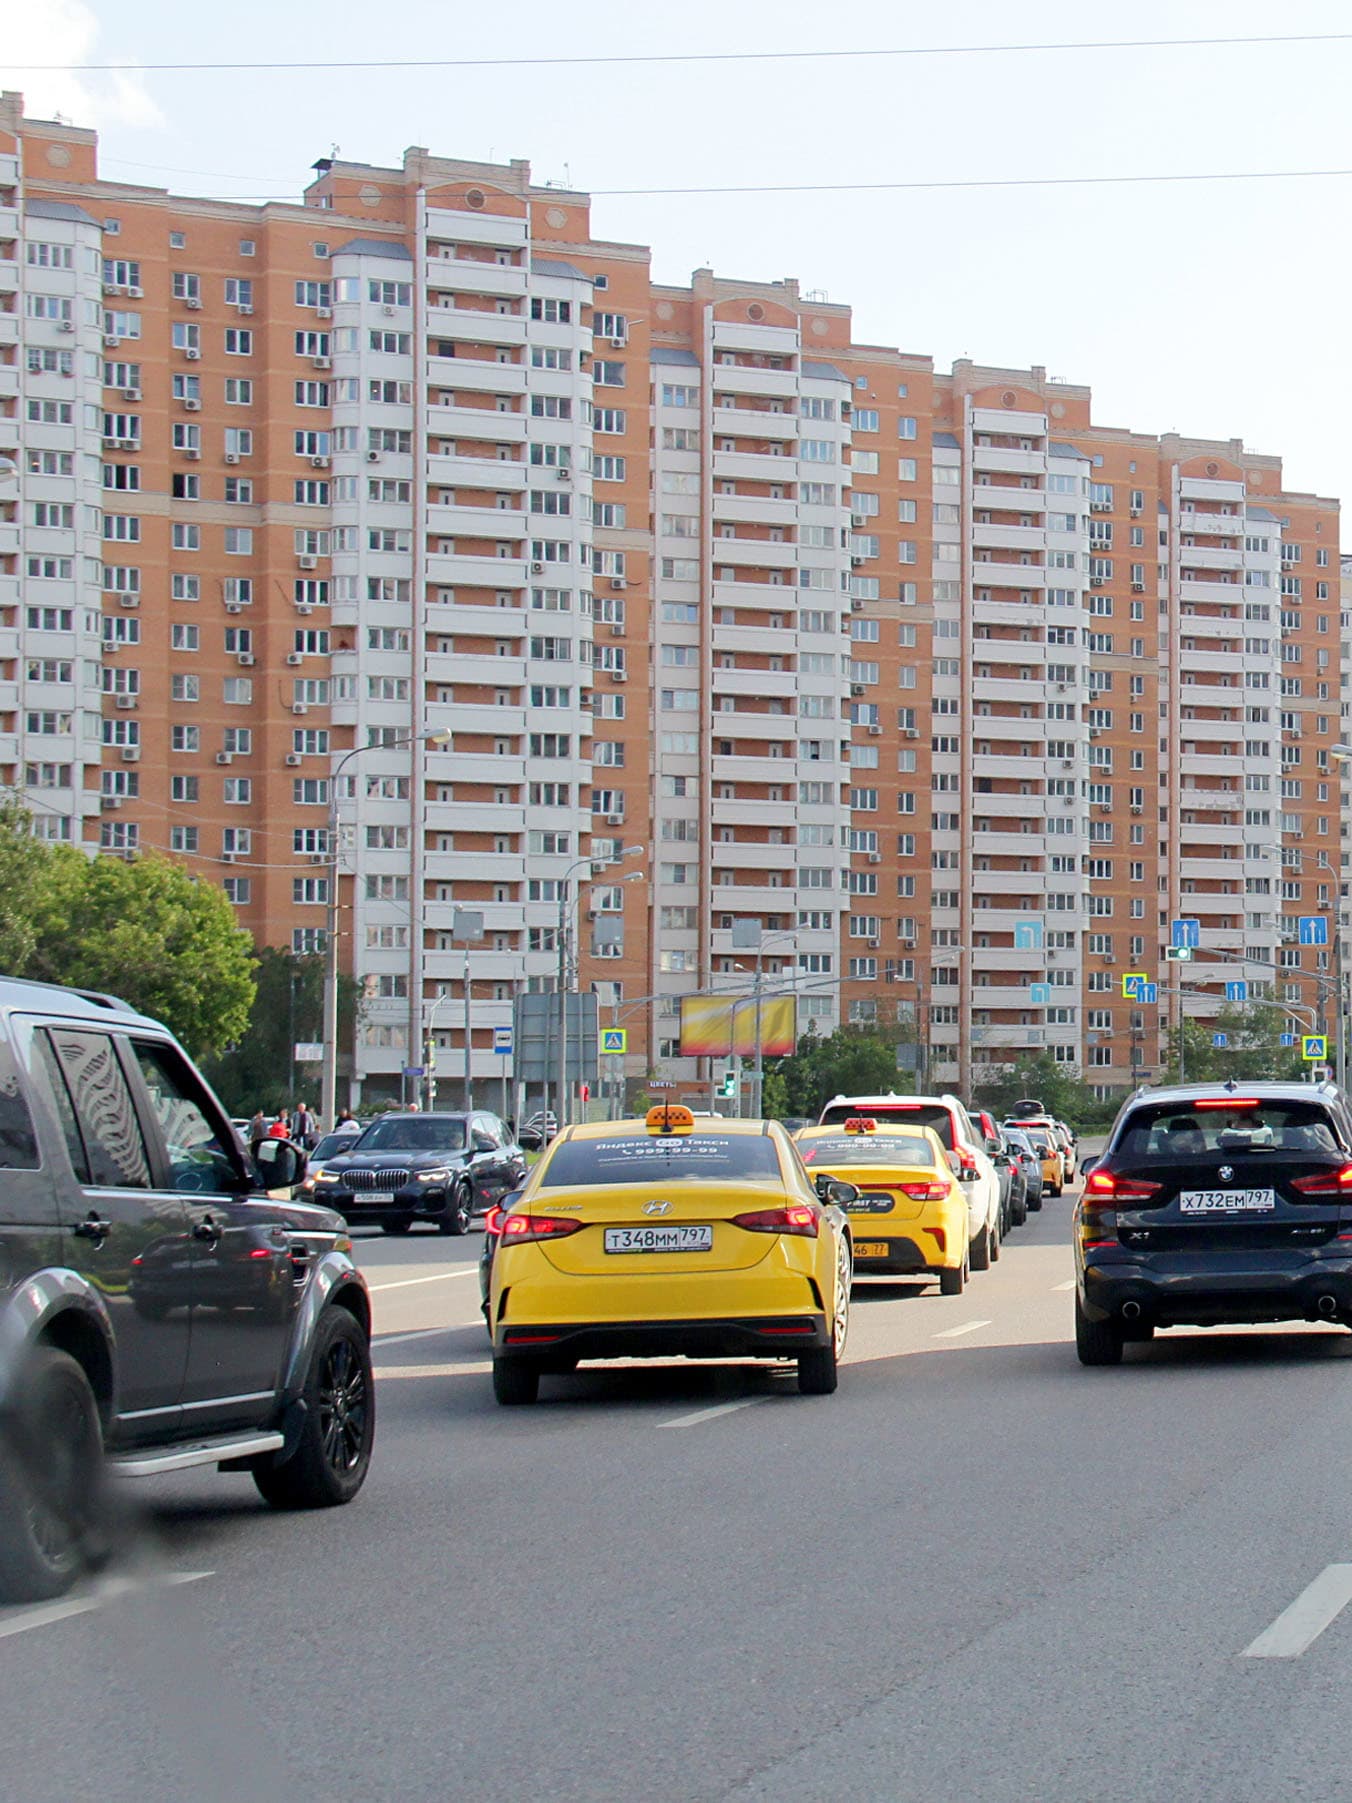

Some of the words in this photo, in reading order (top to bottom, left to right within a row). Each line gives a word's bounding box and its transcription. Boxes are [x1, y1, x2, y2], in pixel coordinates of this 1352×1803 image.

[596, 1140, 651, 1150] Яндекс
[1247, 1191, 1270, 1203] 797
[681, 1228, 707, 1242] 797
